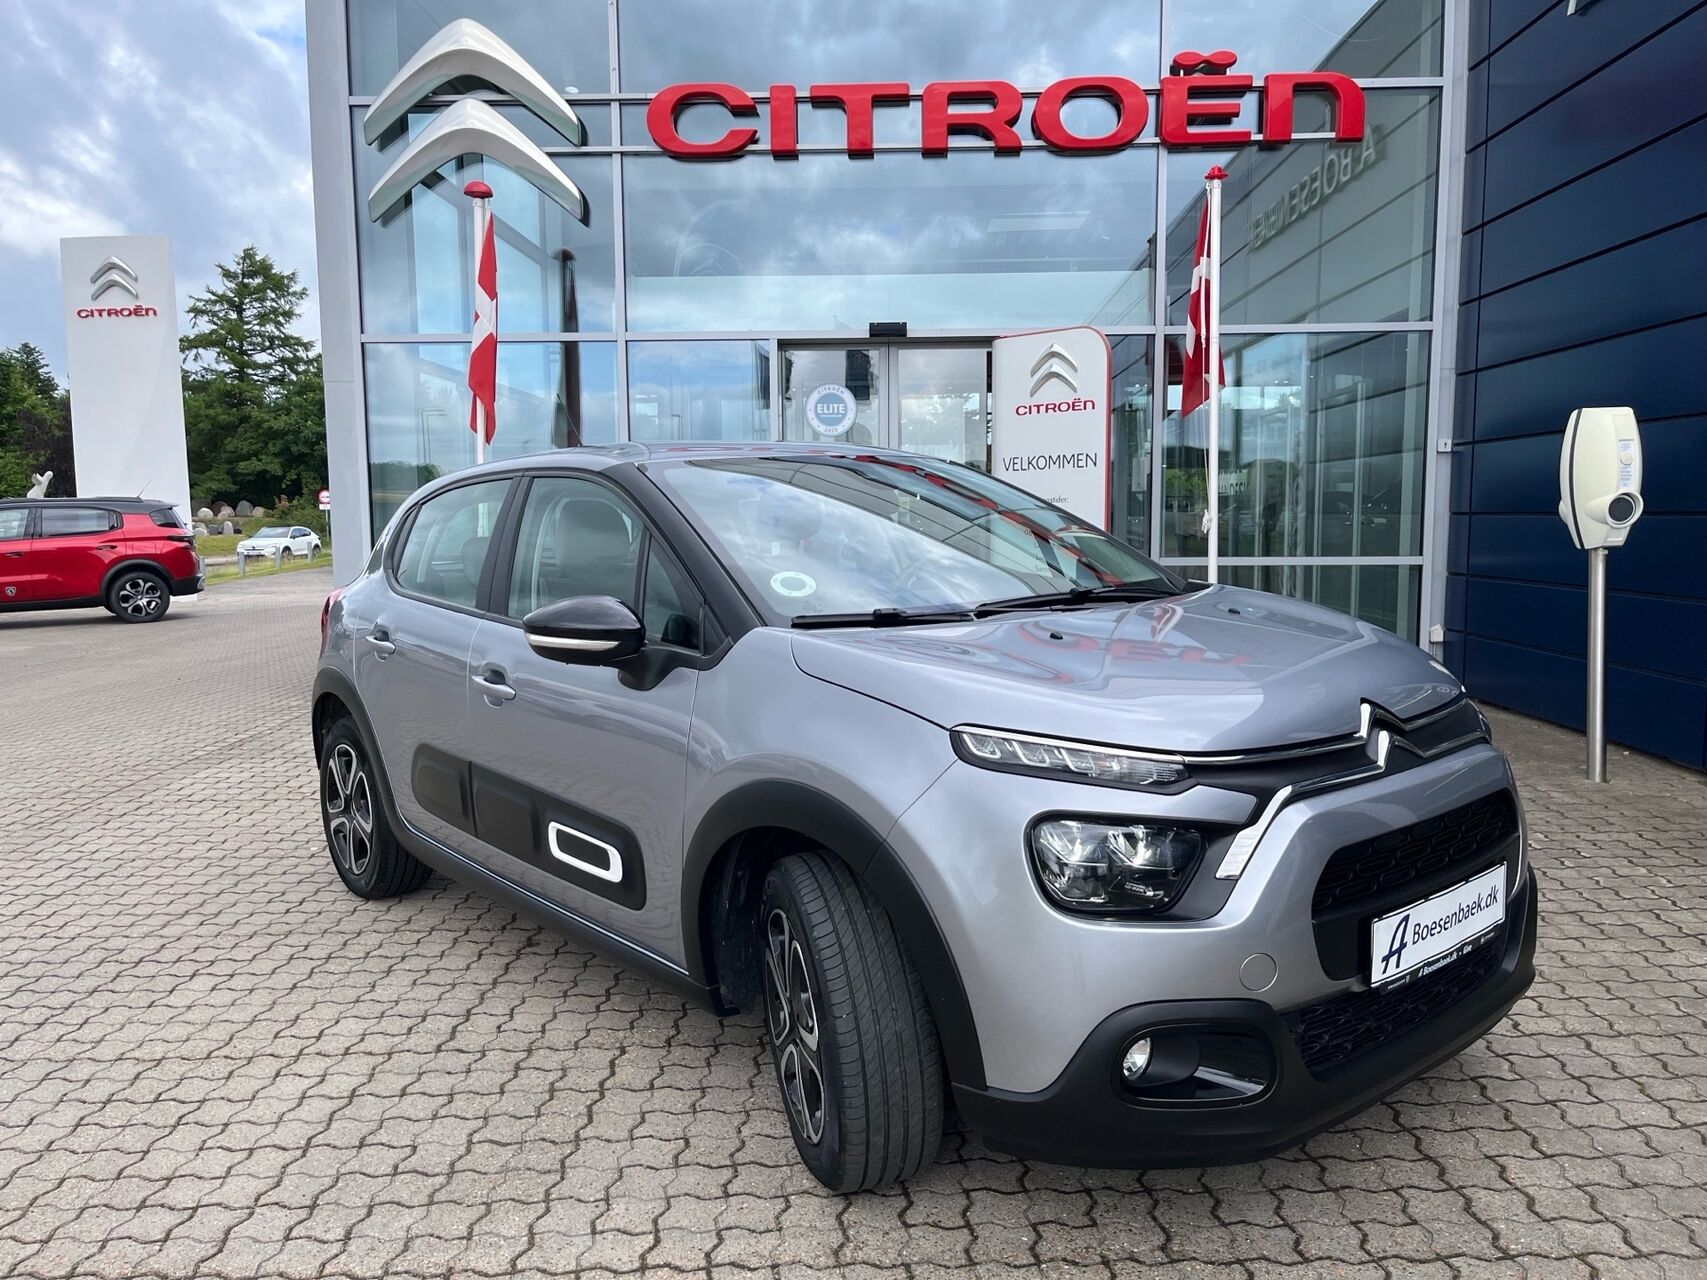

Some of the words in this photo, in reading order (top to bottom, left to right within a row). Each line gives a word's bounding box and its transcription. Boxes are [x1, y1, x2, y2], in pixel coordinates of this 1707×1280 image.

[647, 50, 1366, 159] CITROËN
[76, 304, 158, 319] CITROËN
[817, 404, 846, 414] ELITE
[1015, 398, 1096, 416] CITROËN
[1002, 453, 1097, 472] VELKOMMEN
[1412, 886, 1499, 945] Boesenbaek.dk
